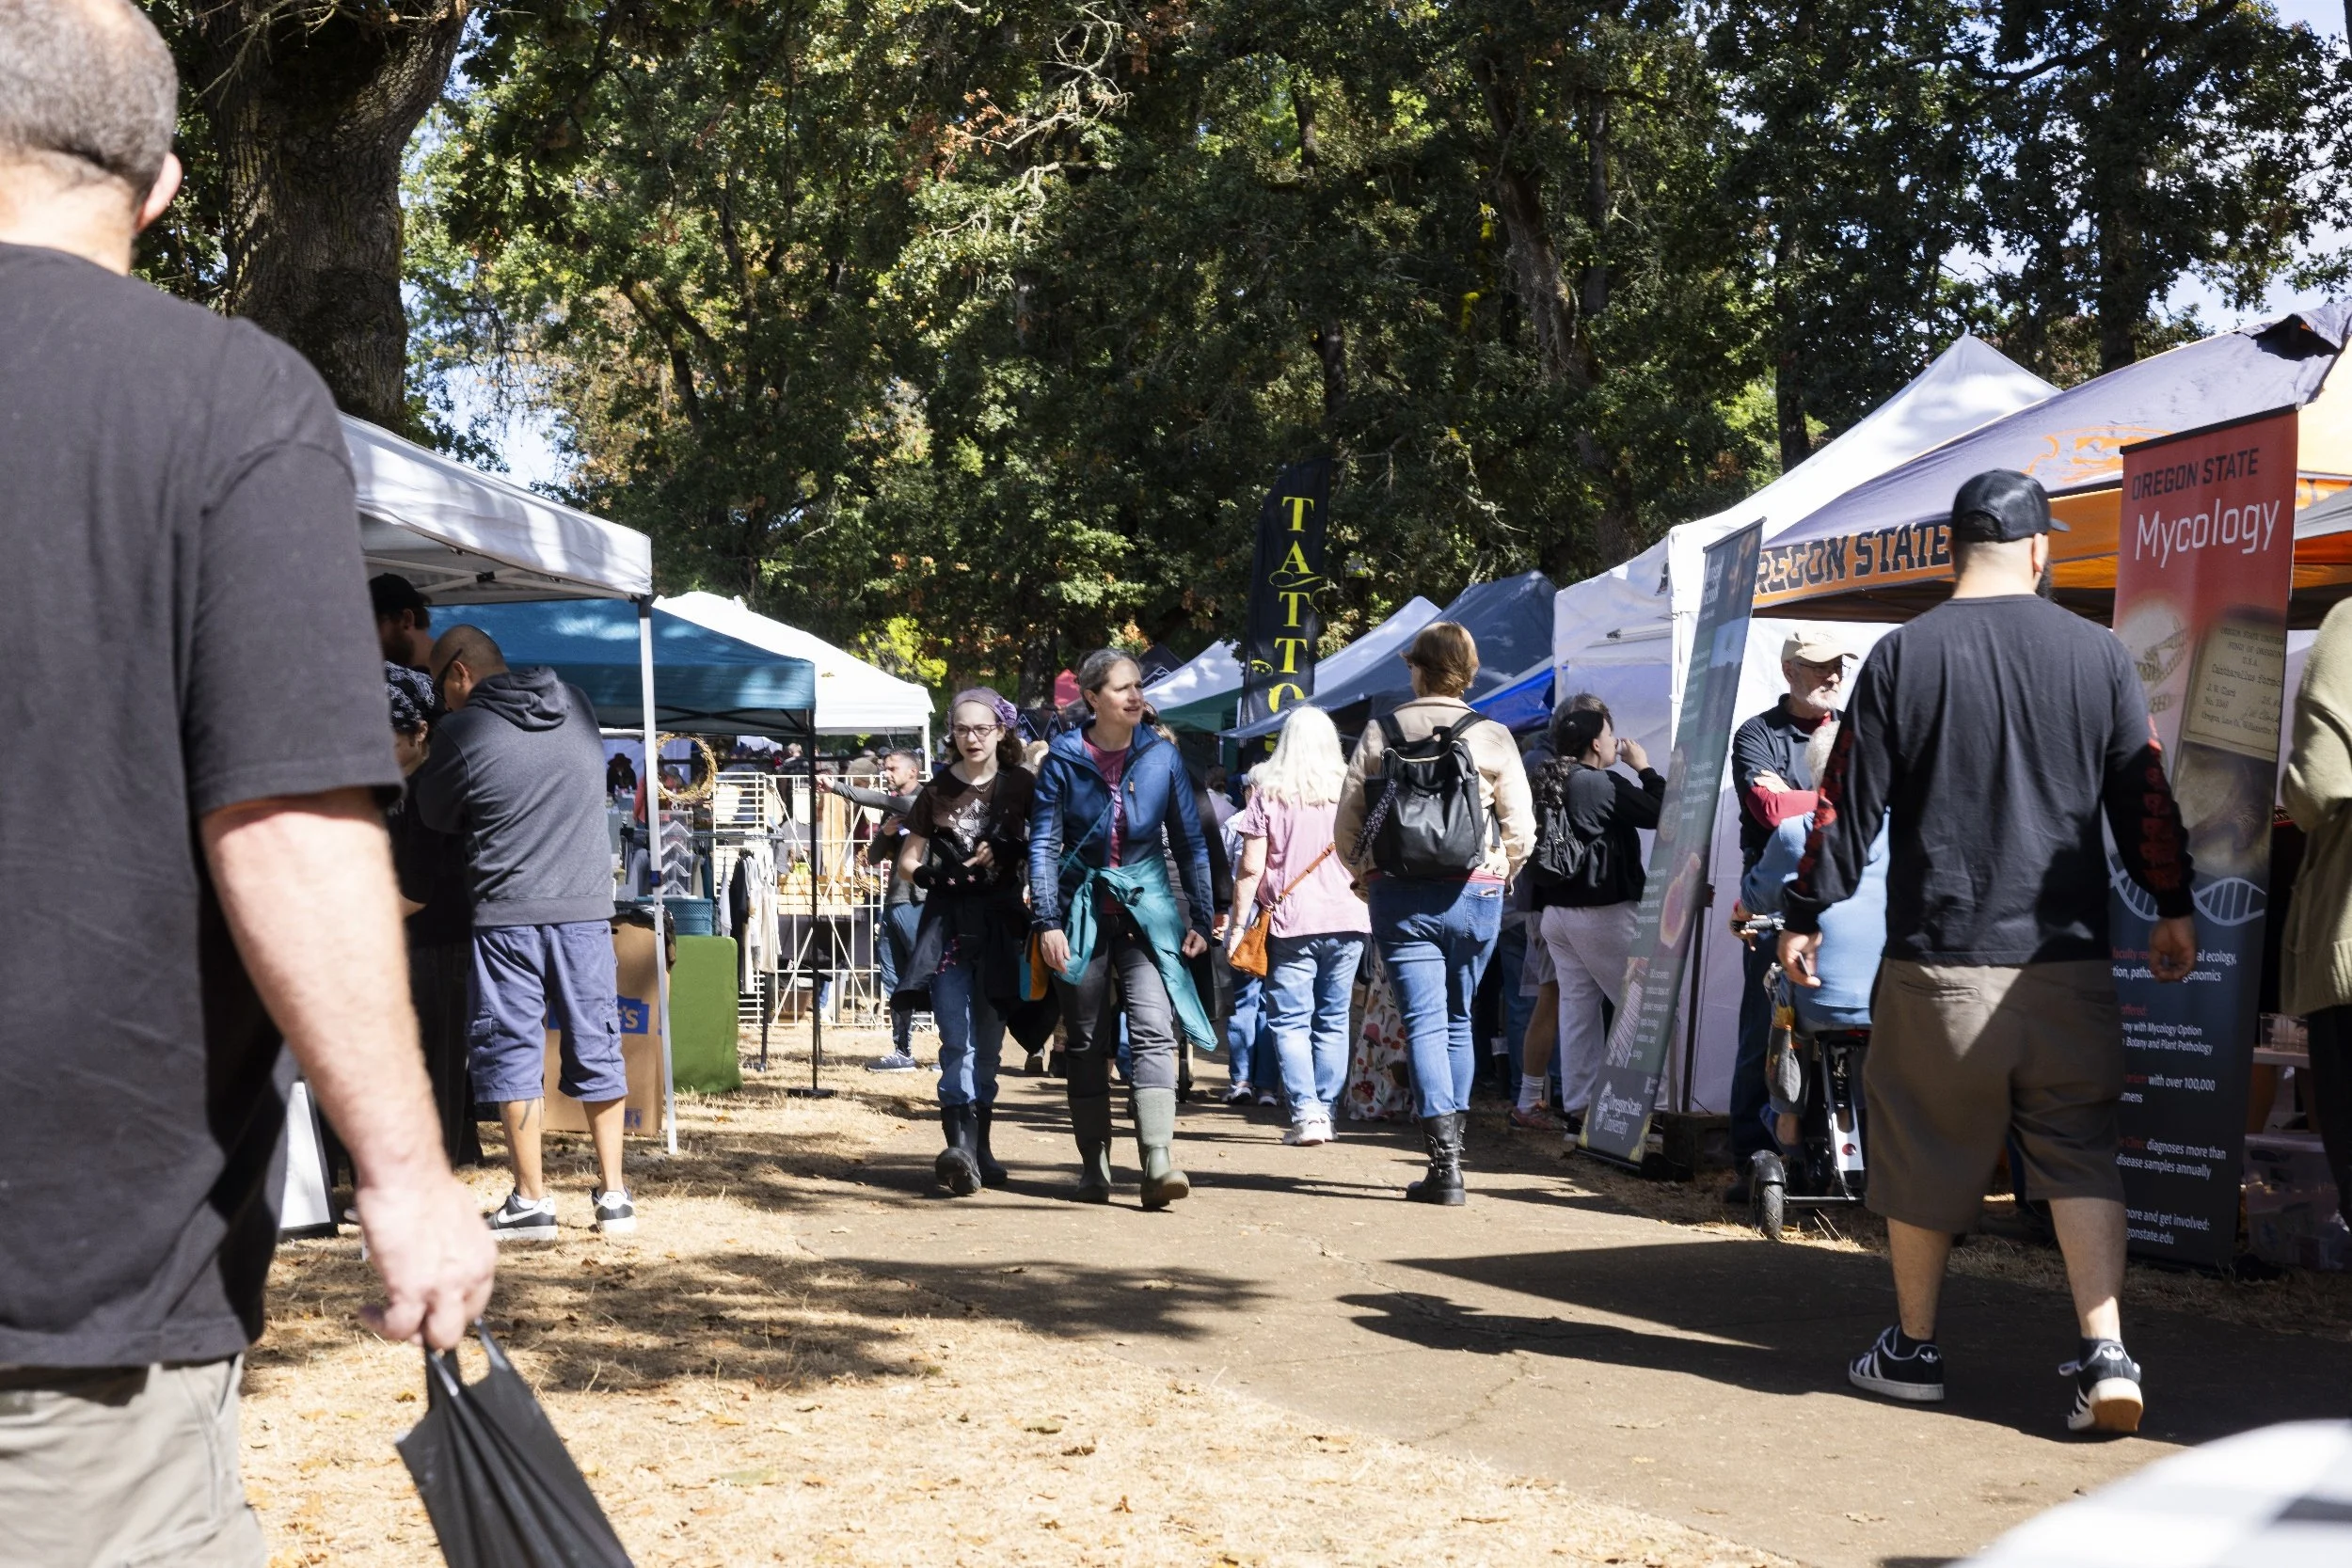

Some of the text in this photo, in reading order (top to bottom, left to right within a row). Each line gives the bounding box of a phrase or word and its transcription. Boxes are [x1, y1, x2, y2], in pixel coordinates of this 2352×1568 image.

[2132, 448, 2260, 500] OREGON STATE
[2136, 498, 2280, 569] Mycology
[1754, 535, 1850, 595] REGON
[1264, 496, 1315, 752] TATTO
[2197, 949, 2237, 966] al ecology,
[2112, 965, 2154, 981] tion, patho
[2147, 1022, 2177, 1037] Mycology
[2177, 1024, 2202, 1038] Option
[2126, 1037, 2147, 1051] Botany
[2147, 1037, 2160, 1050] and
[2178, 1040, 2213, 1056] Pathology
[2148, 1074, 2164, 1086] with
[2165, 1077, 2183, 1088] over
[2184, 1077, 2216, 1092] 100,000
[2146, 1138, 2185, 1156] diagnoses
[2185, 1144, 2207, 1158] more
[2208, 1146, 2226, 1161] than
[2116, 1153, 2212, 1180] disease samples annually
[2143, 1211, 2158, 1224] and
[2159, 1213, 2172, 1227] get
[2172, 1213, 2210, 1232] involved:
[2125, 1227, 2174, 1246] gonstate.edu
